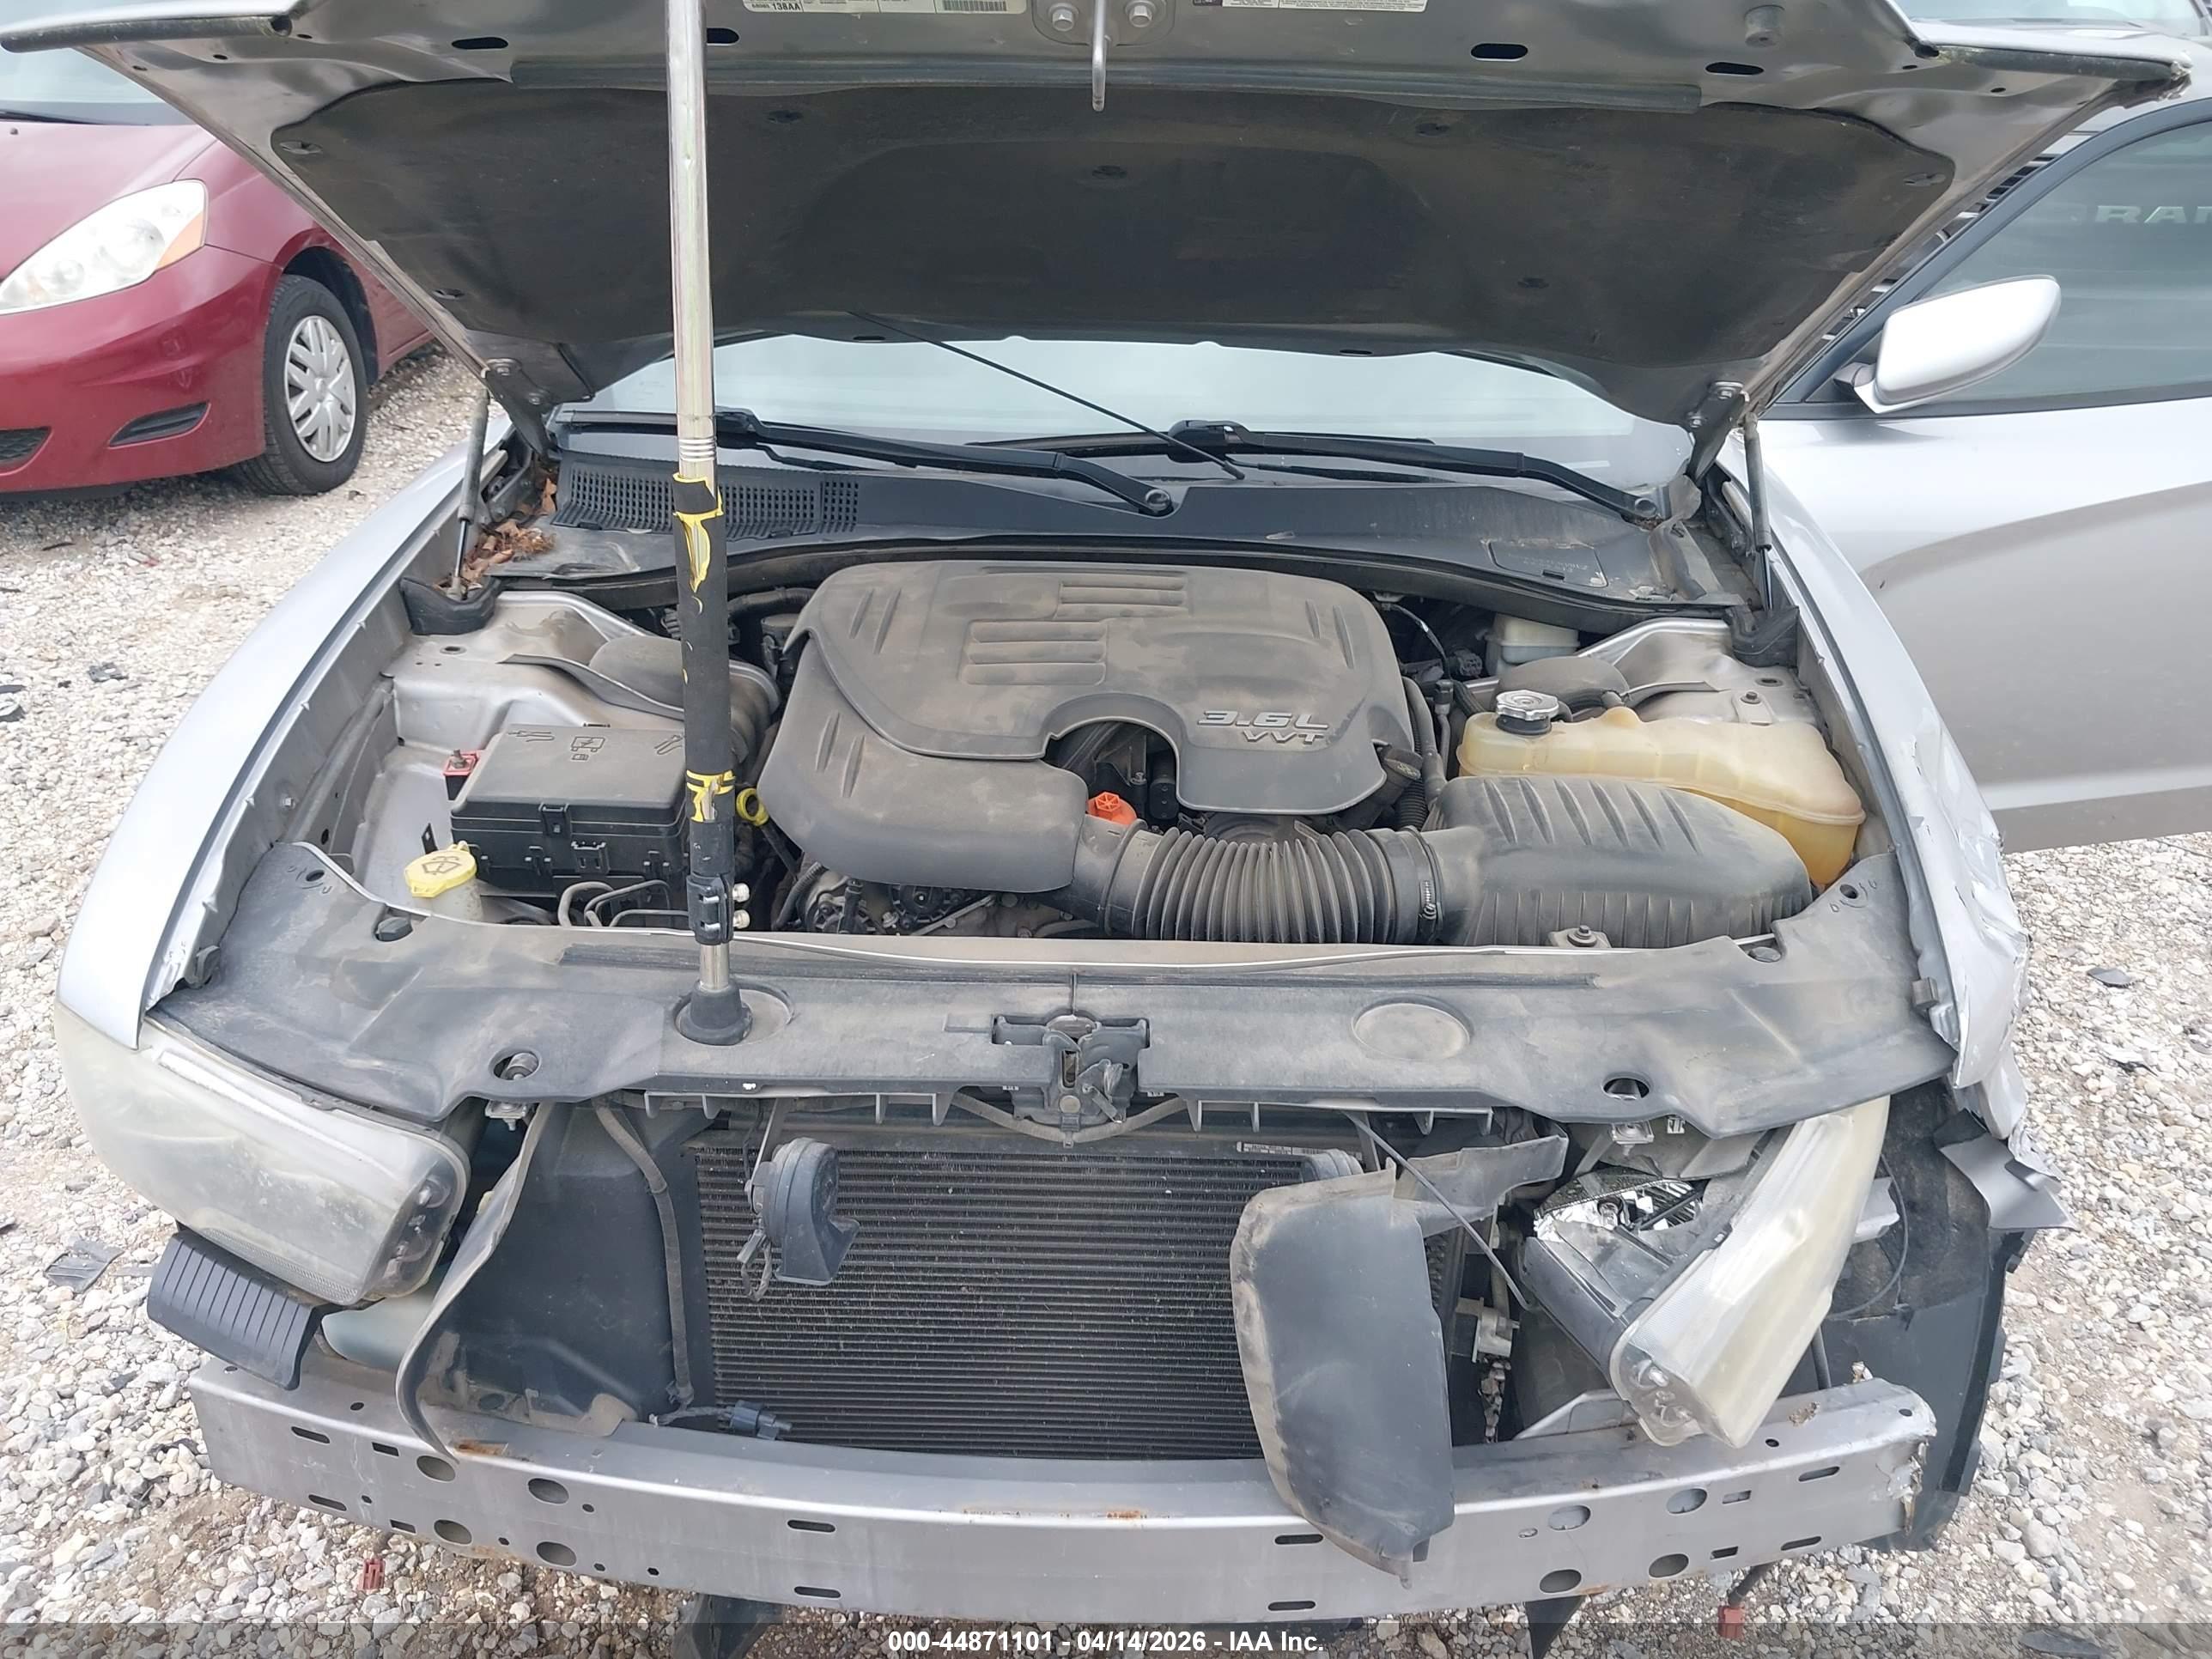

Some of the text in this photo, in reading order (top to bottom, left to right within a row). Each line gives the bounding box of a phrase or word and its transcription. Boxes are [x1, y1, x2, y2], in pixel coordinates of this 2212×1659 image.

[772, 3, 801, 11] 138AA
[1197, 710, 1329, 728] 3.6L
[1242, 730, 1325, 744] VVT
